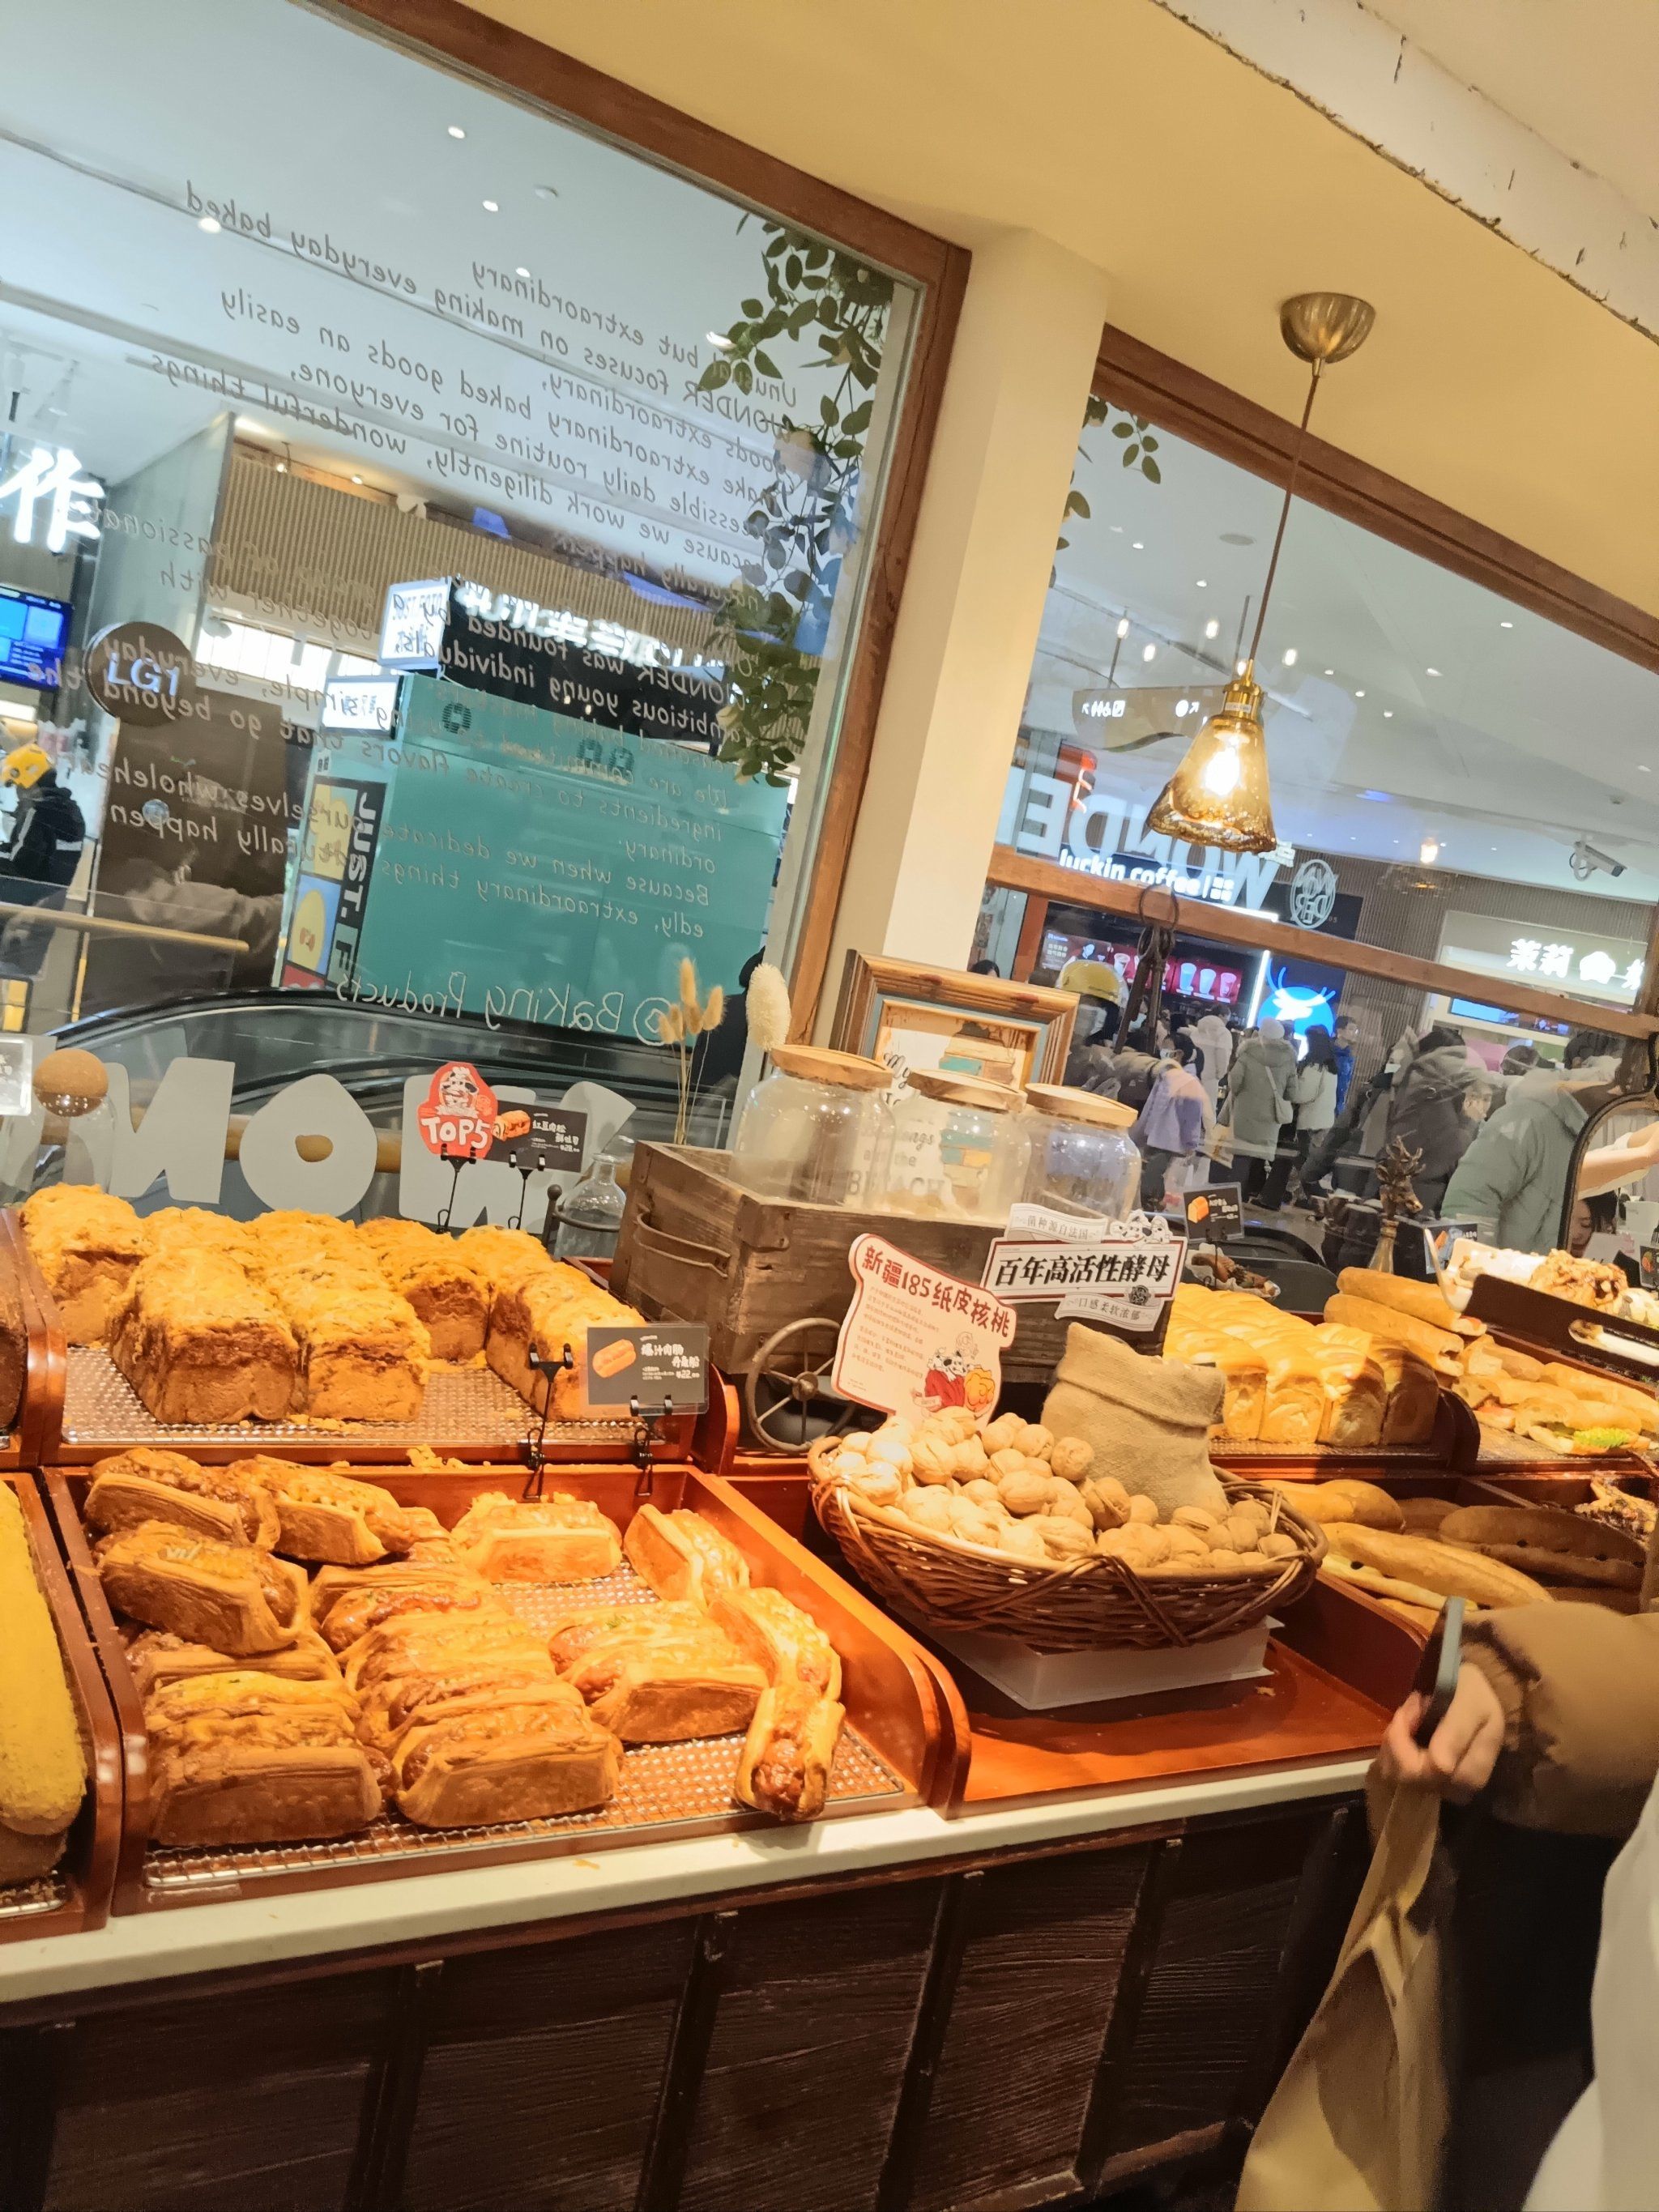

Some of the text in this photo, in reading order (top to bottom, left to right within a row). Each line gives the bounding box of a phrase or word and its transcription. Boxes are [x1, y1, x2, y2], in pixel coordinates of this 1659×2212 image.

[107, 651, 180, 697] LG1
[1059, 848, 1127, 883] luckin
[1129, 864, 1201, 898] coffee
[420, 1116, 491, 1149] TOP5
[862, 1245, 1011, 1337] 新疆185纸皮核桃
[995, 1254, 1171, 1286] 百年高活性酵母
